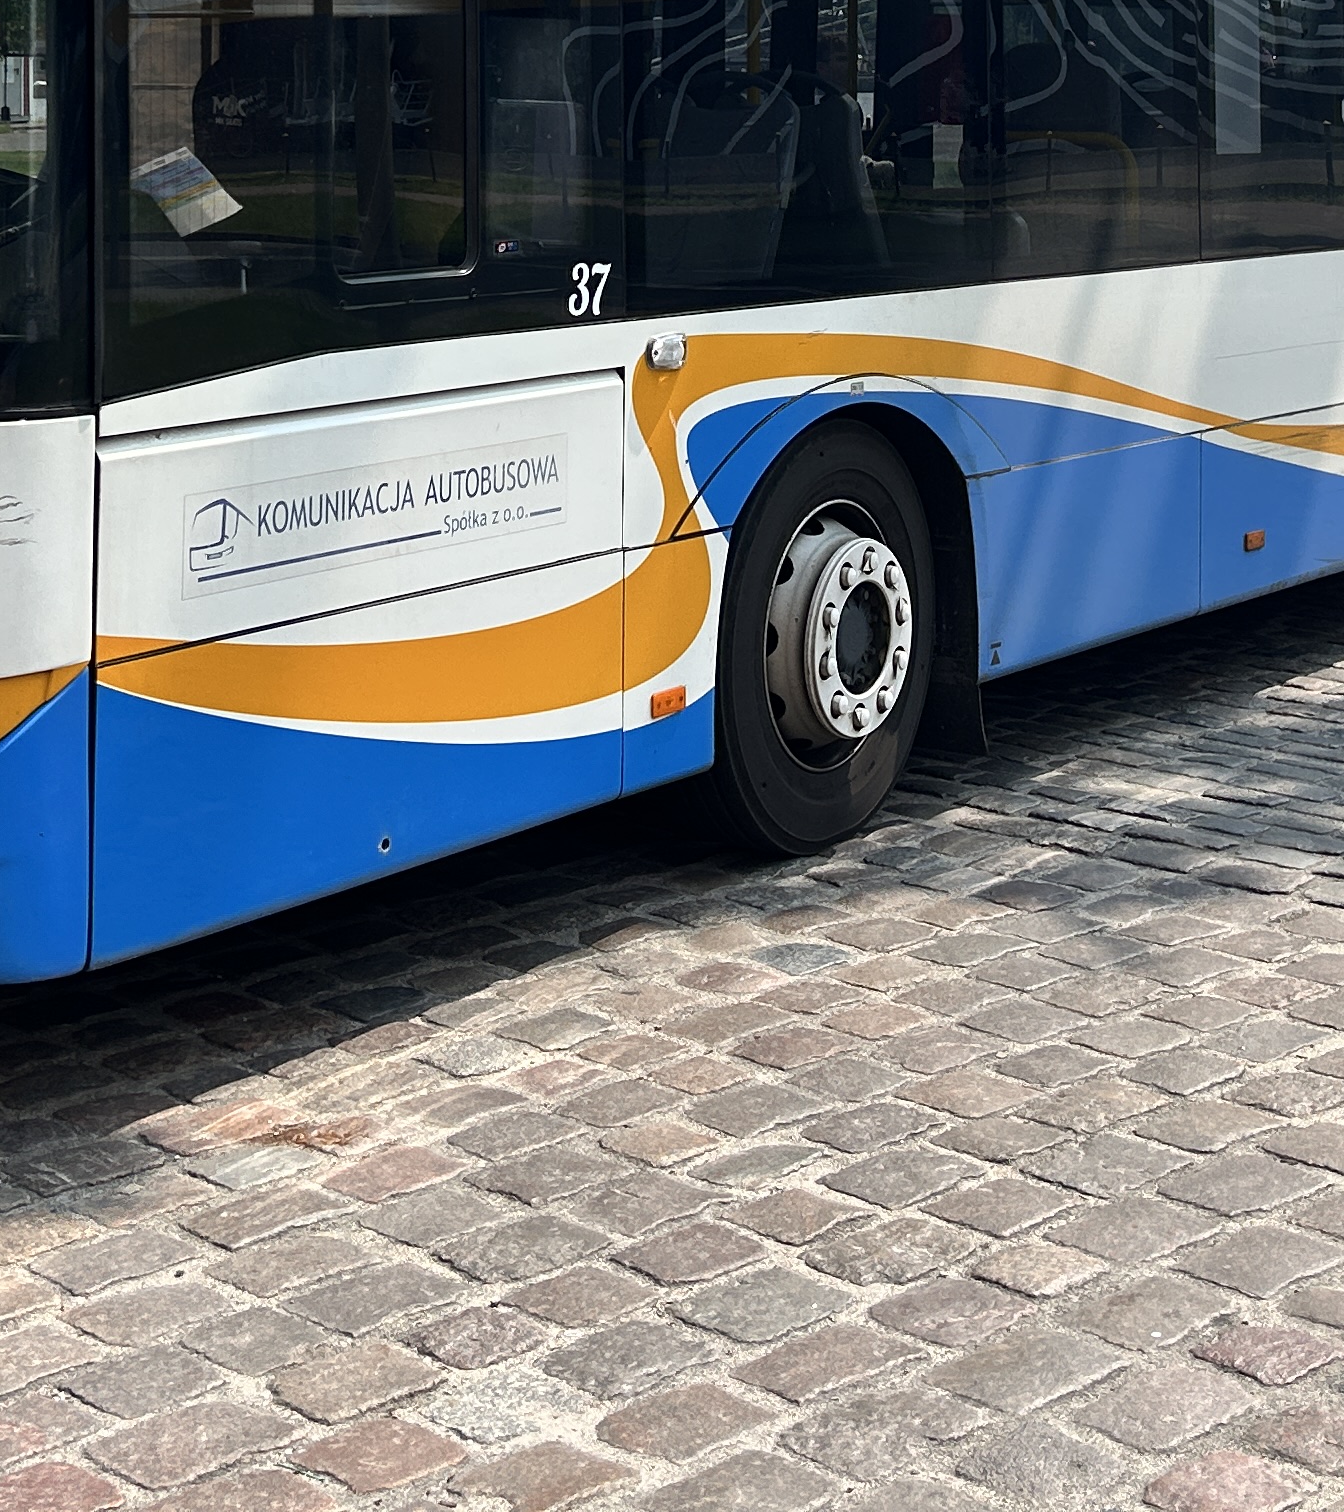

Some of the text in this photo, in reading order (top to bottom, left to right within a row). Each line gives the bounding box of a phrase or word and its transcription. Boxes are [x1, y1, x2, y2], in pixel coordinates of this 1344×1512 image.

[568, 262, 612, 316] 37
[257, 453, 559, 538] KOMUNIKACJA AUTOBUSOWA
[443, 504, 529, 537] Spółka z o.o.
